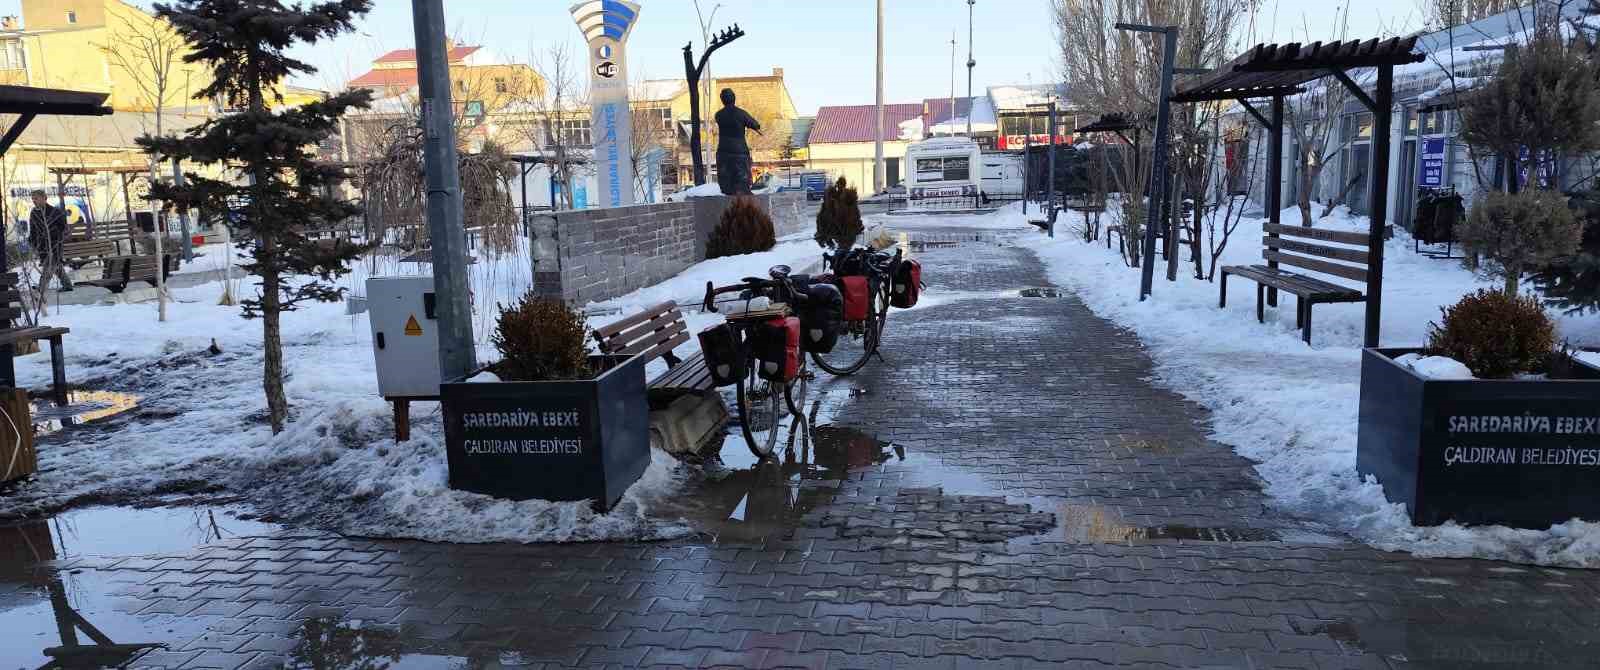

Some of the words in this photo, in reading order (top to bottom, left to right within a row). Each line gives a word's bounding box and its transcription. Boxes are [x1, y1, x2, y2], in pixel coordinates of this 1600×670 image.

[464, 439, 518, 456] ÇALDIRAN
[521, 436, 583, 455] BELEDİYESİ
[1444, 445, 1516, 467] ÇALDIRAN
